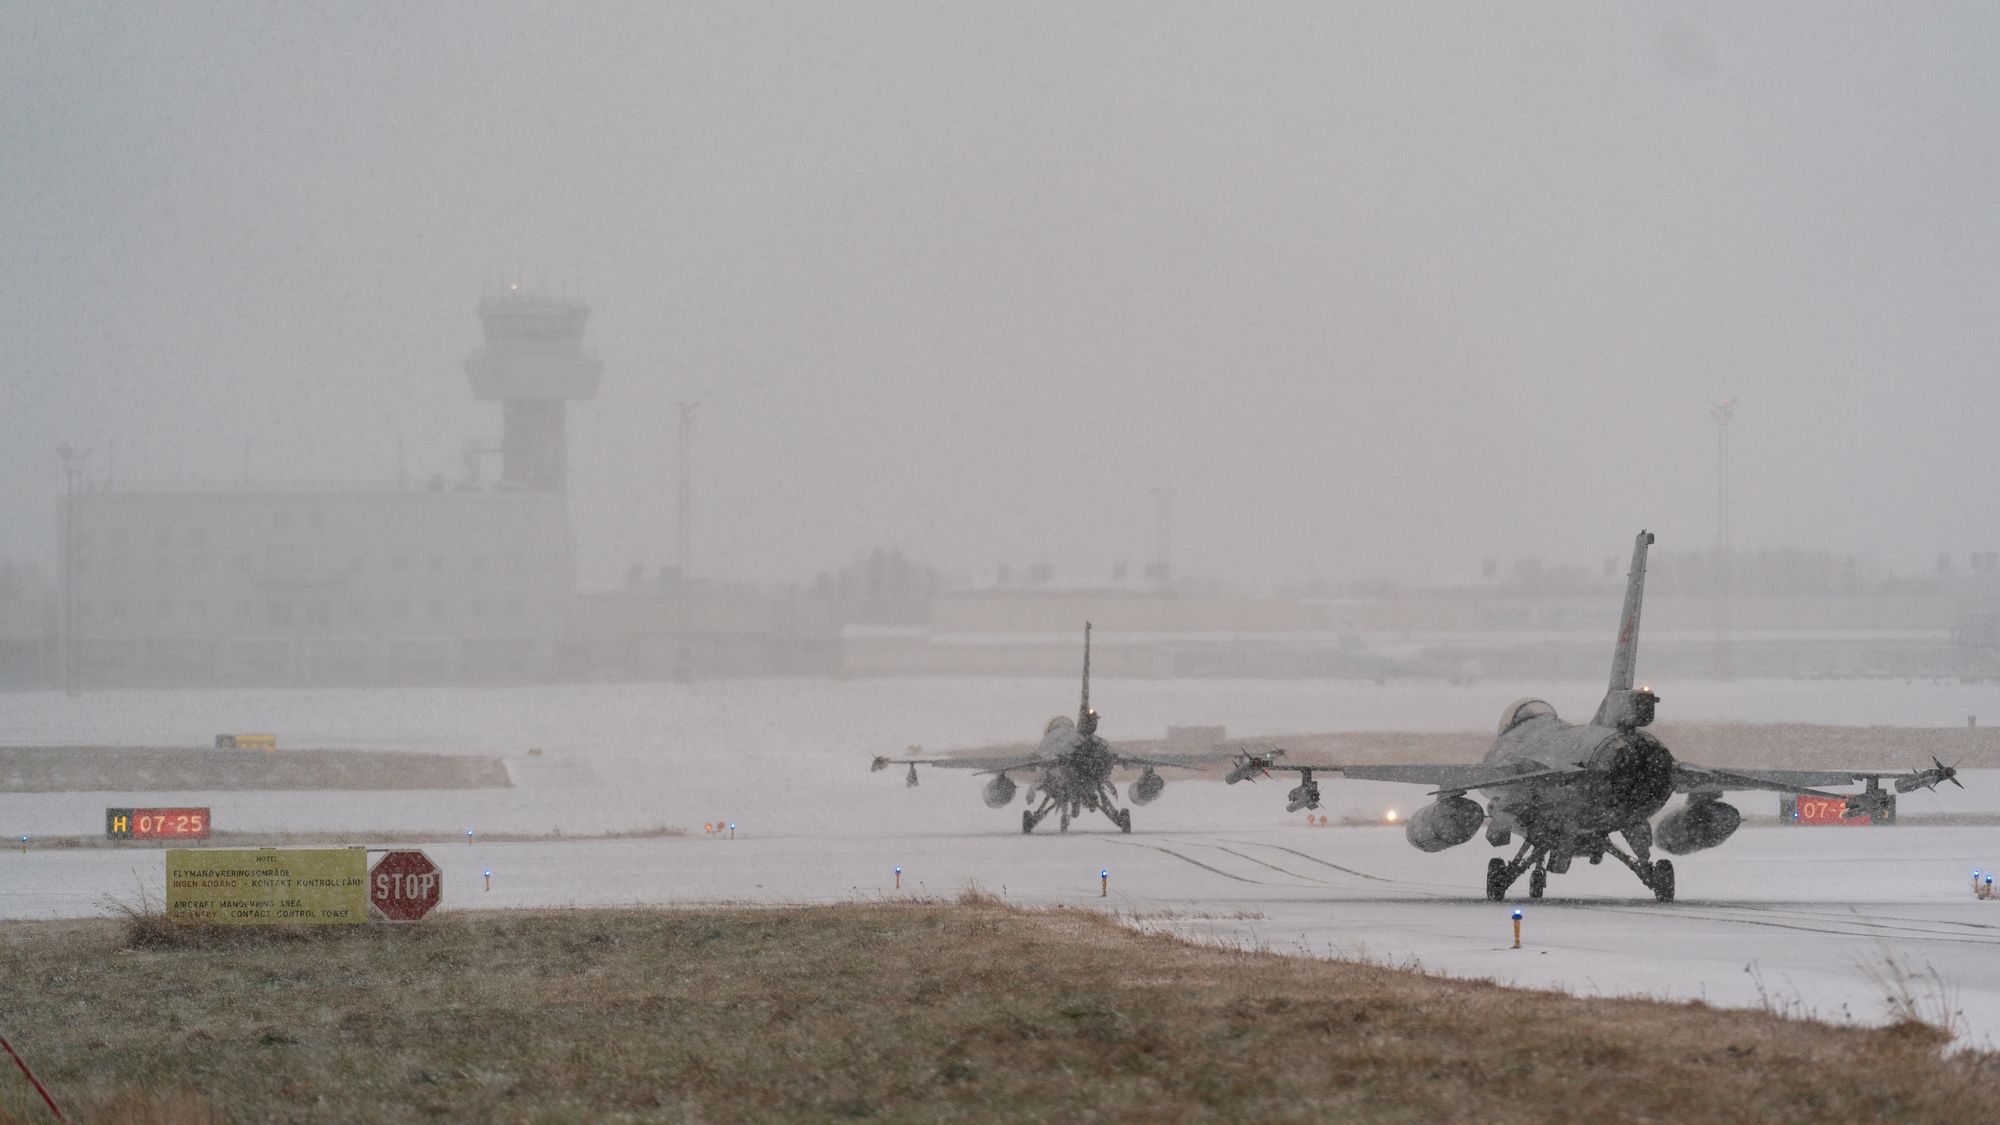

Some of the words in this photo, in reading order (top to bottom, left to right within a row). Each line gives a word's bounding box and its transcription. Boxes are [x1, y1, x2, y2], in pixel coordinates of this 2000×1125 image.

[113, 816, 127, 833] H
[140, 815, 202, 833] 07-25
[173, 880, 198, 888] INGEN
[377, 873, 434, 900] STOP
[174, 901, 214, 909] AIRCRAFT
[230, 910, 271, 918] CONTACT
[277, 910, 317, 918] CONTROL
